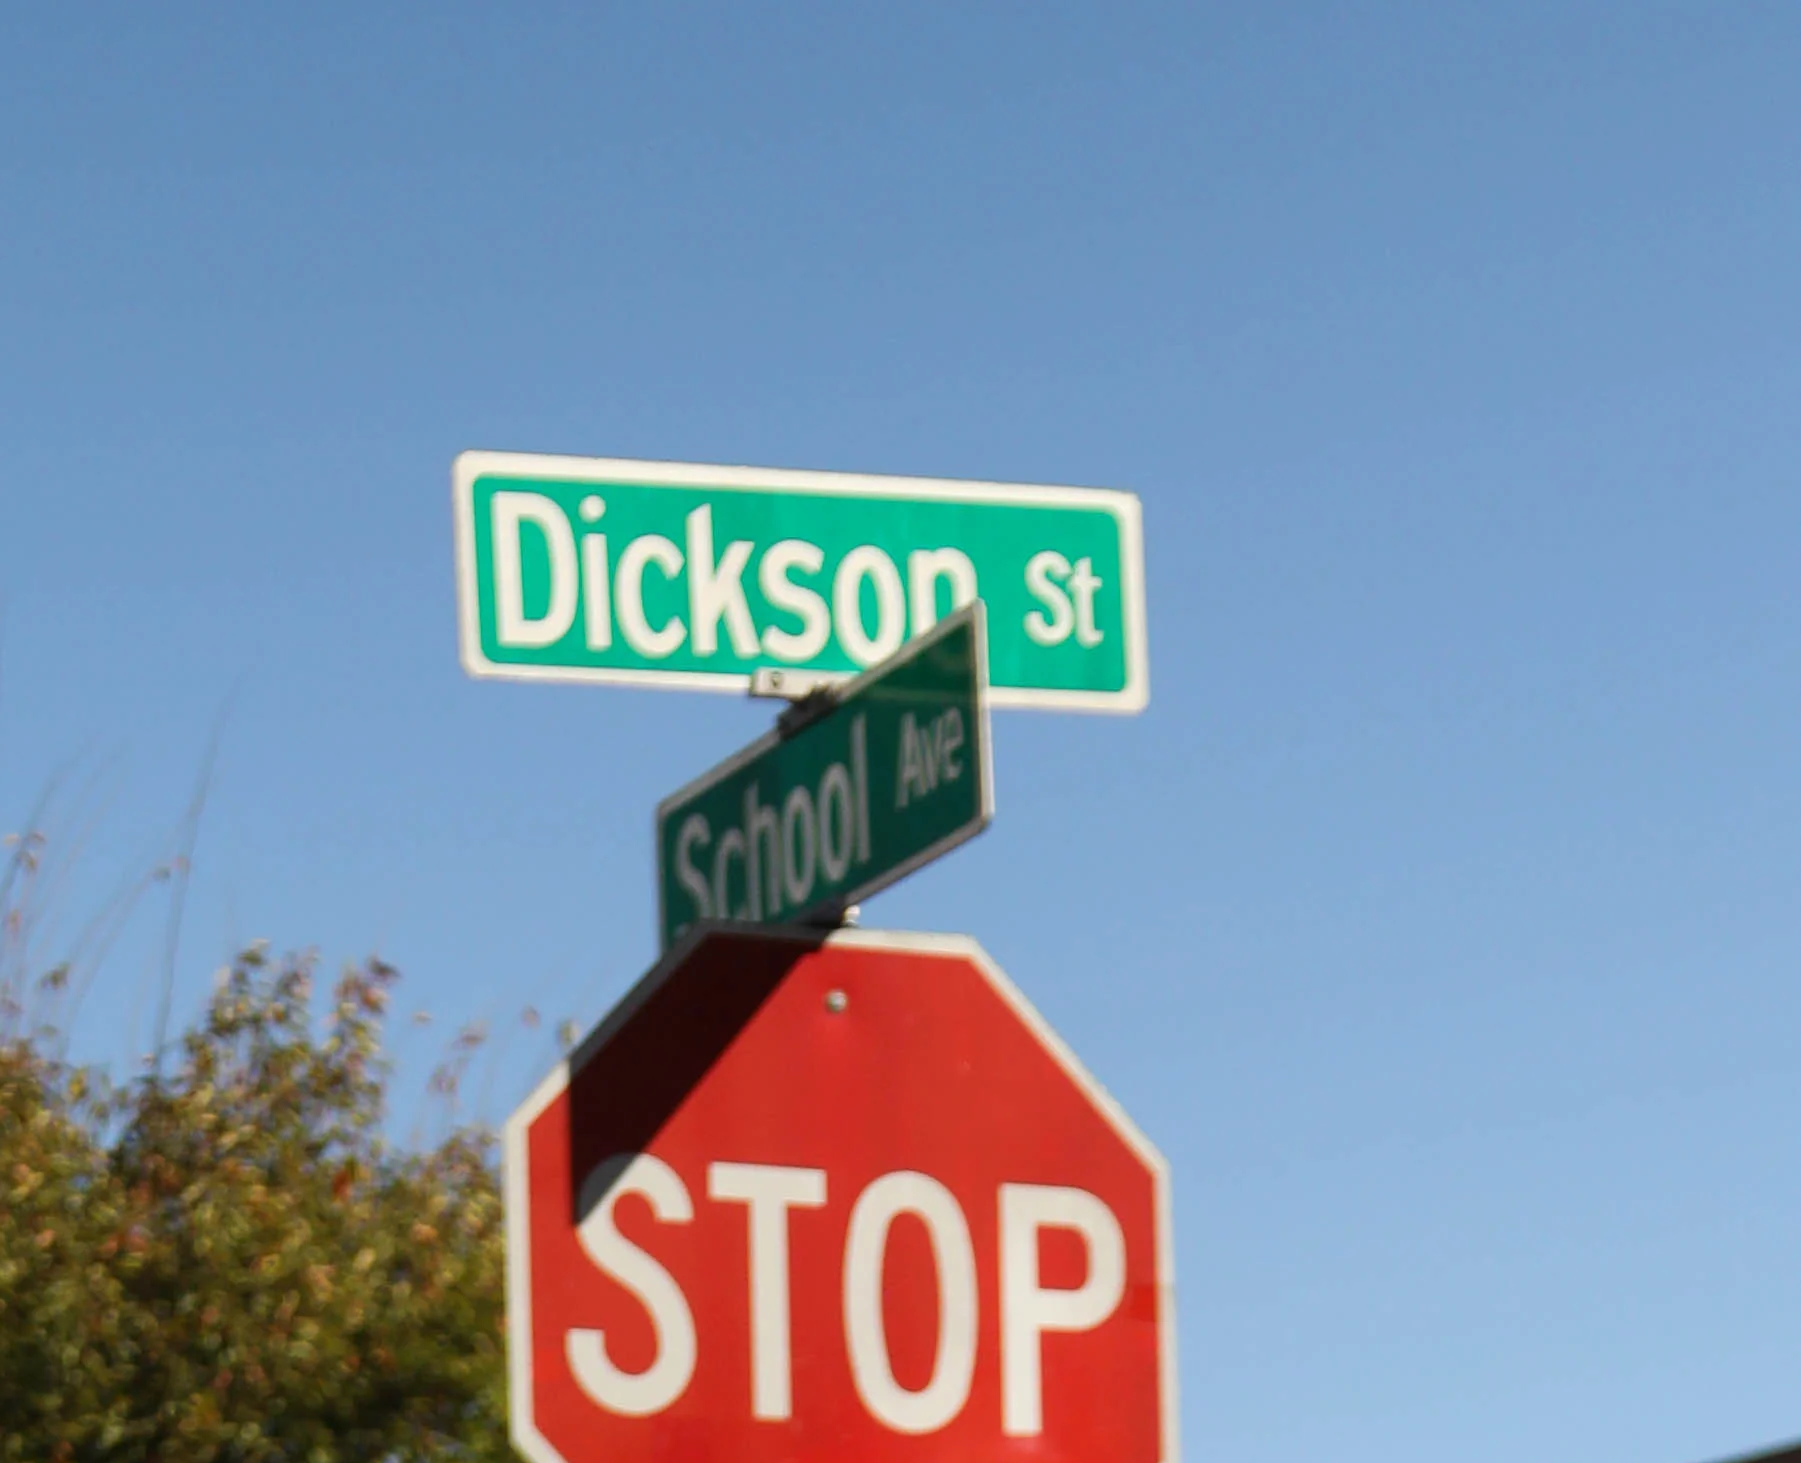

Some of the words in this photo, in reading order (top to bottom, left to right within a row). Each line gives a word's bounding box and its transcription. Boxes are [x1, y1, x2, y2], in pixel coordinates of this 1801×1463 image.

[490, 489, 978, 663] Dickson
[1023, 549, 1105, 648] St
[674, 709, 872, 923] School
[894, 705, 965, 813] Ave
[564, 1152, 1127, 1438] STOP
